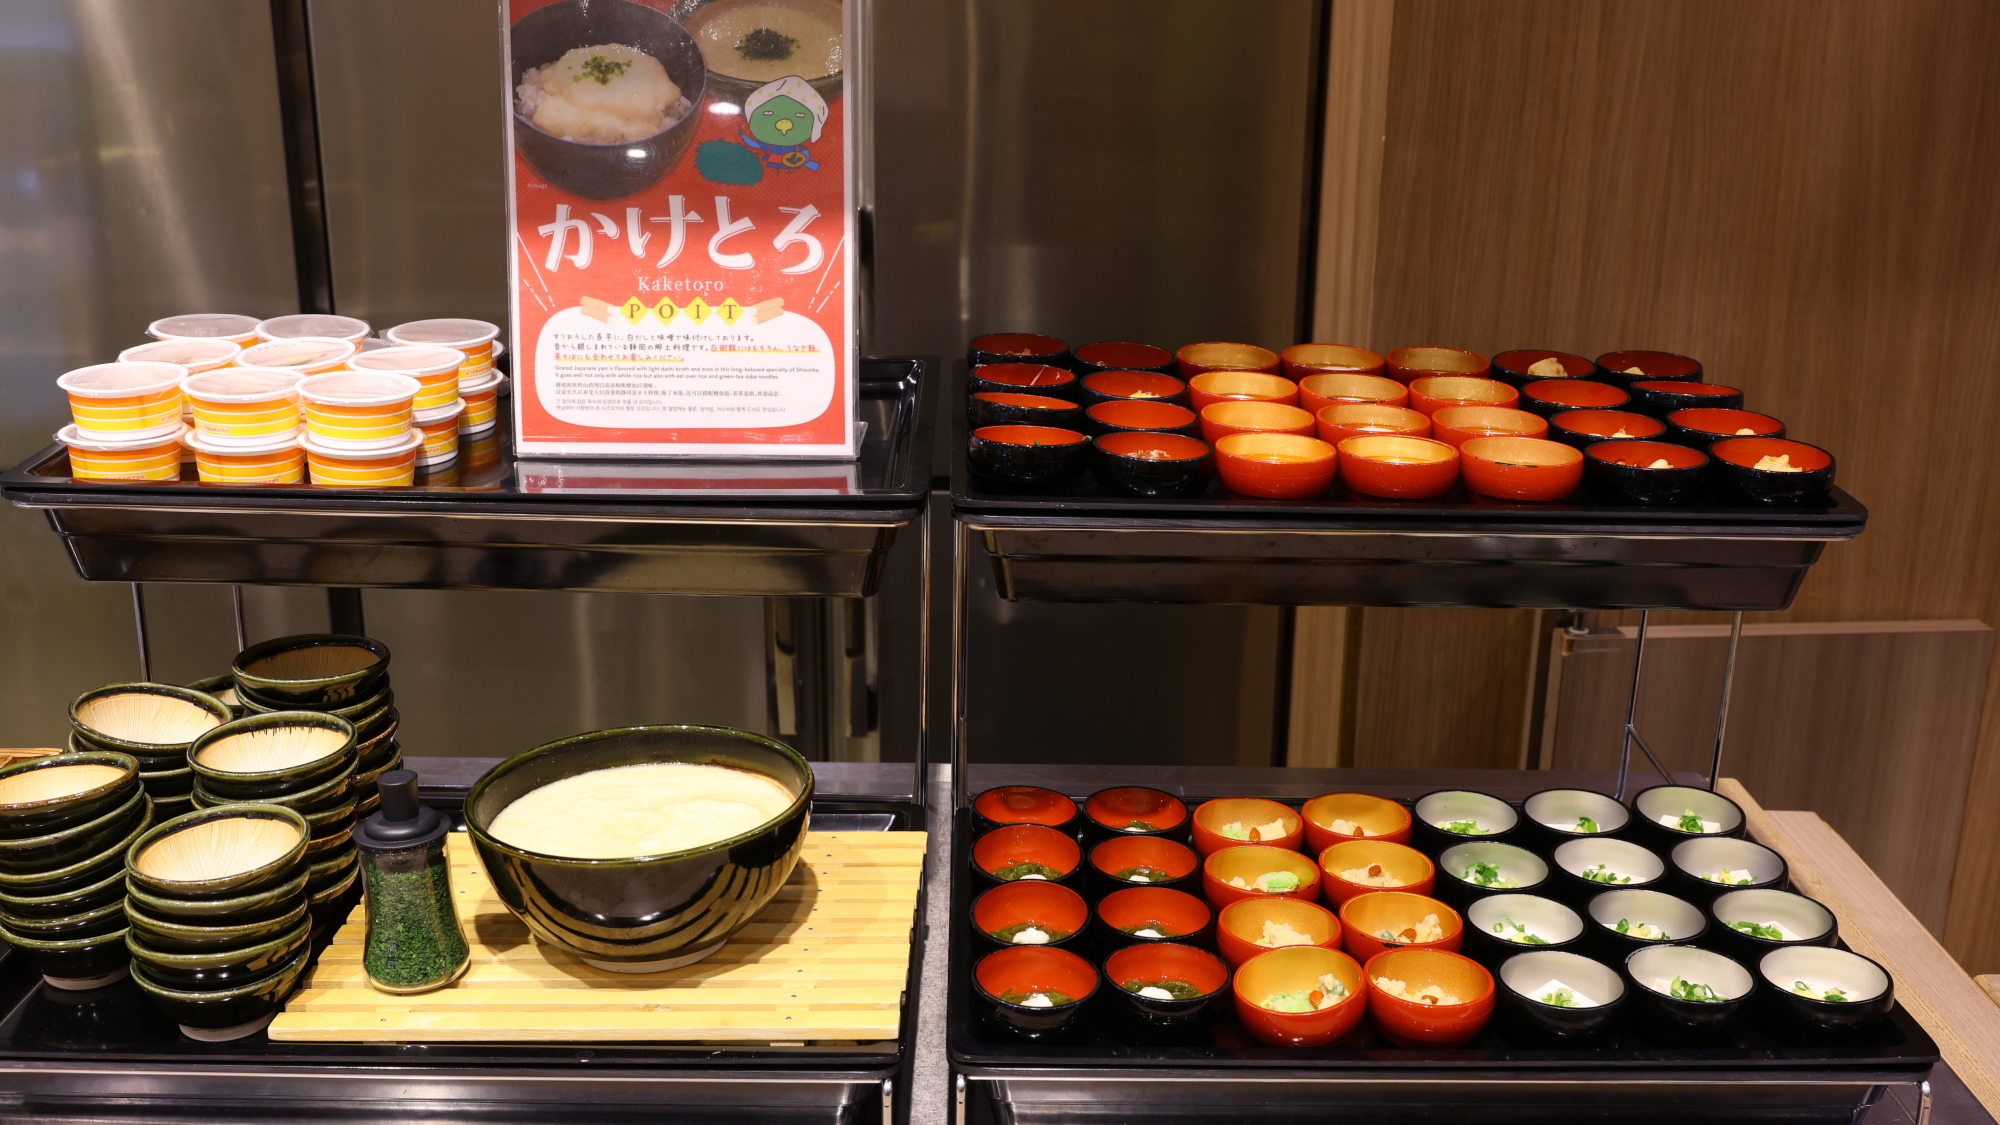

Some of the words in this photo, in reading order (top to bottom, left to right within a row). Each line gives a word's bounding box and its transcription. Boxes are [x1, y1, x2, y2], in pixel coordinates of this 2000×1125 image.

[537, 194, 825, 275] かけとろ
[637, 276, 724, 292] Kaketoro
